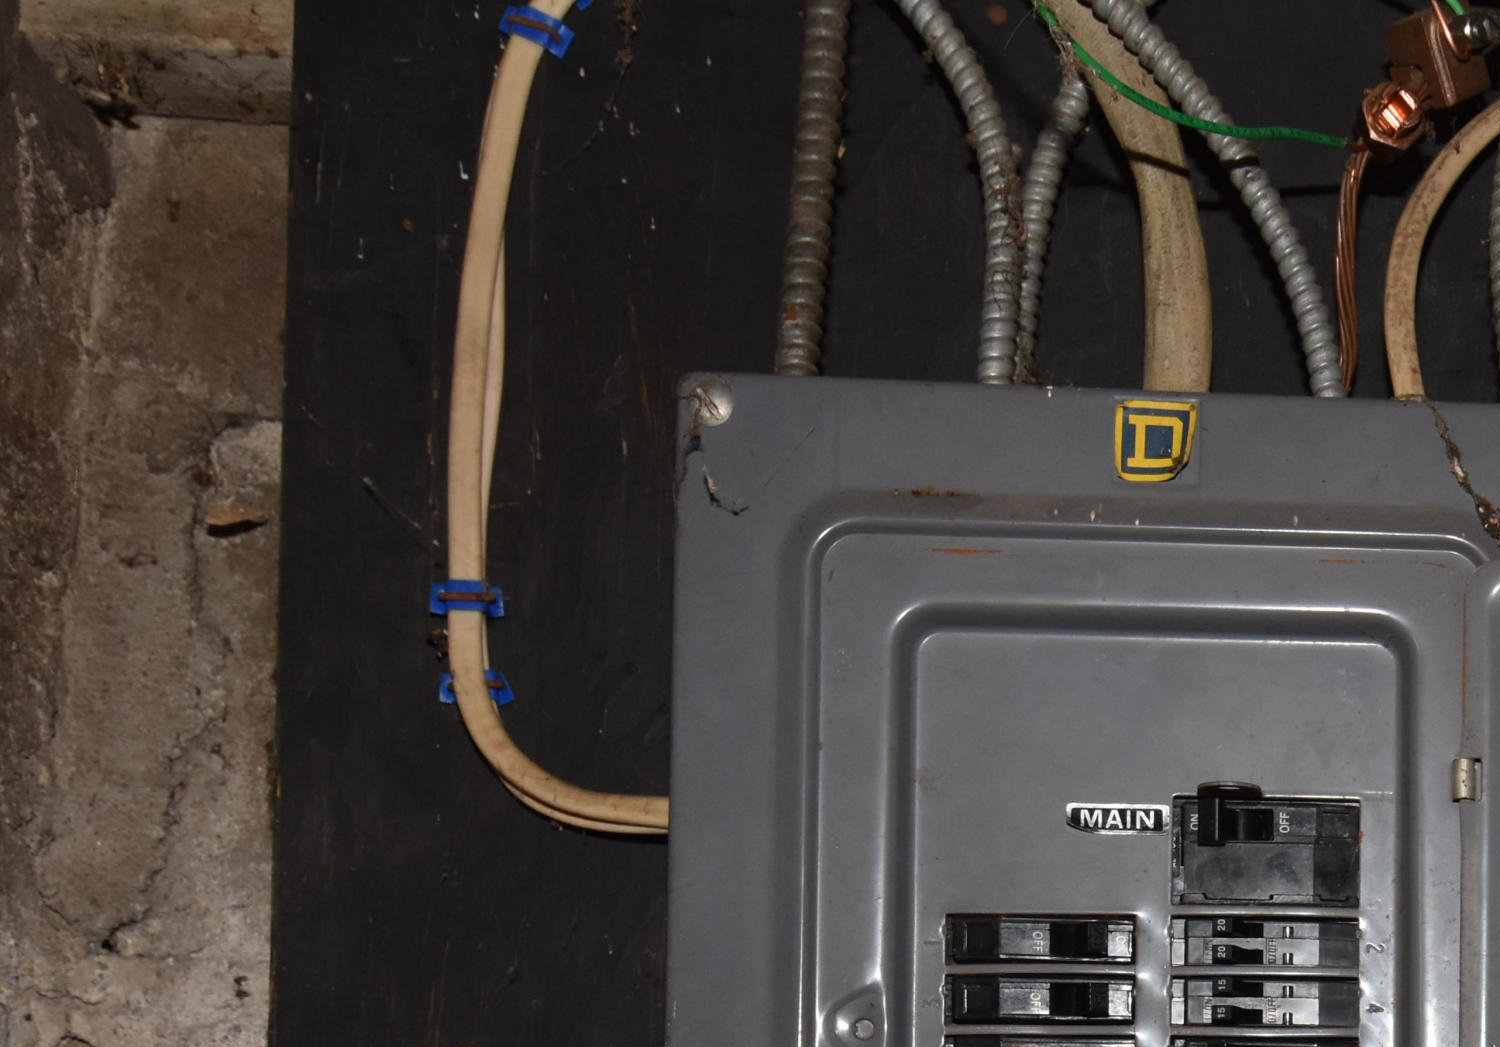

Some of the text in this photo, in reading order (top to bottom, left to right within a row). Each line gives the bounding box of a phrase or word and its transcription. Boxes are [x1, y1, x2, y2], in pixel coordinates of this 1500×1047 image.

[1080, 809, 1155, 829] MAIN
[1279, 812, 1291, 833] OFF
[1217, 918, 1226, 931] 20
[1032, 931, 1043, 953] OFF
[1366, 943, 1385, 953] 2
[1217, 945, 1226, 958] 20
[1217, 978, 1226, 991] 15
[1217, 1006, 1226, 1019] 15
[1366, 1002, 1385, 1013] 4
